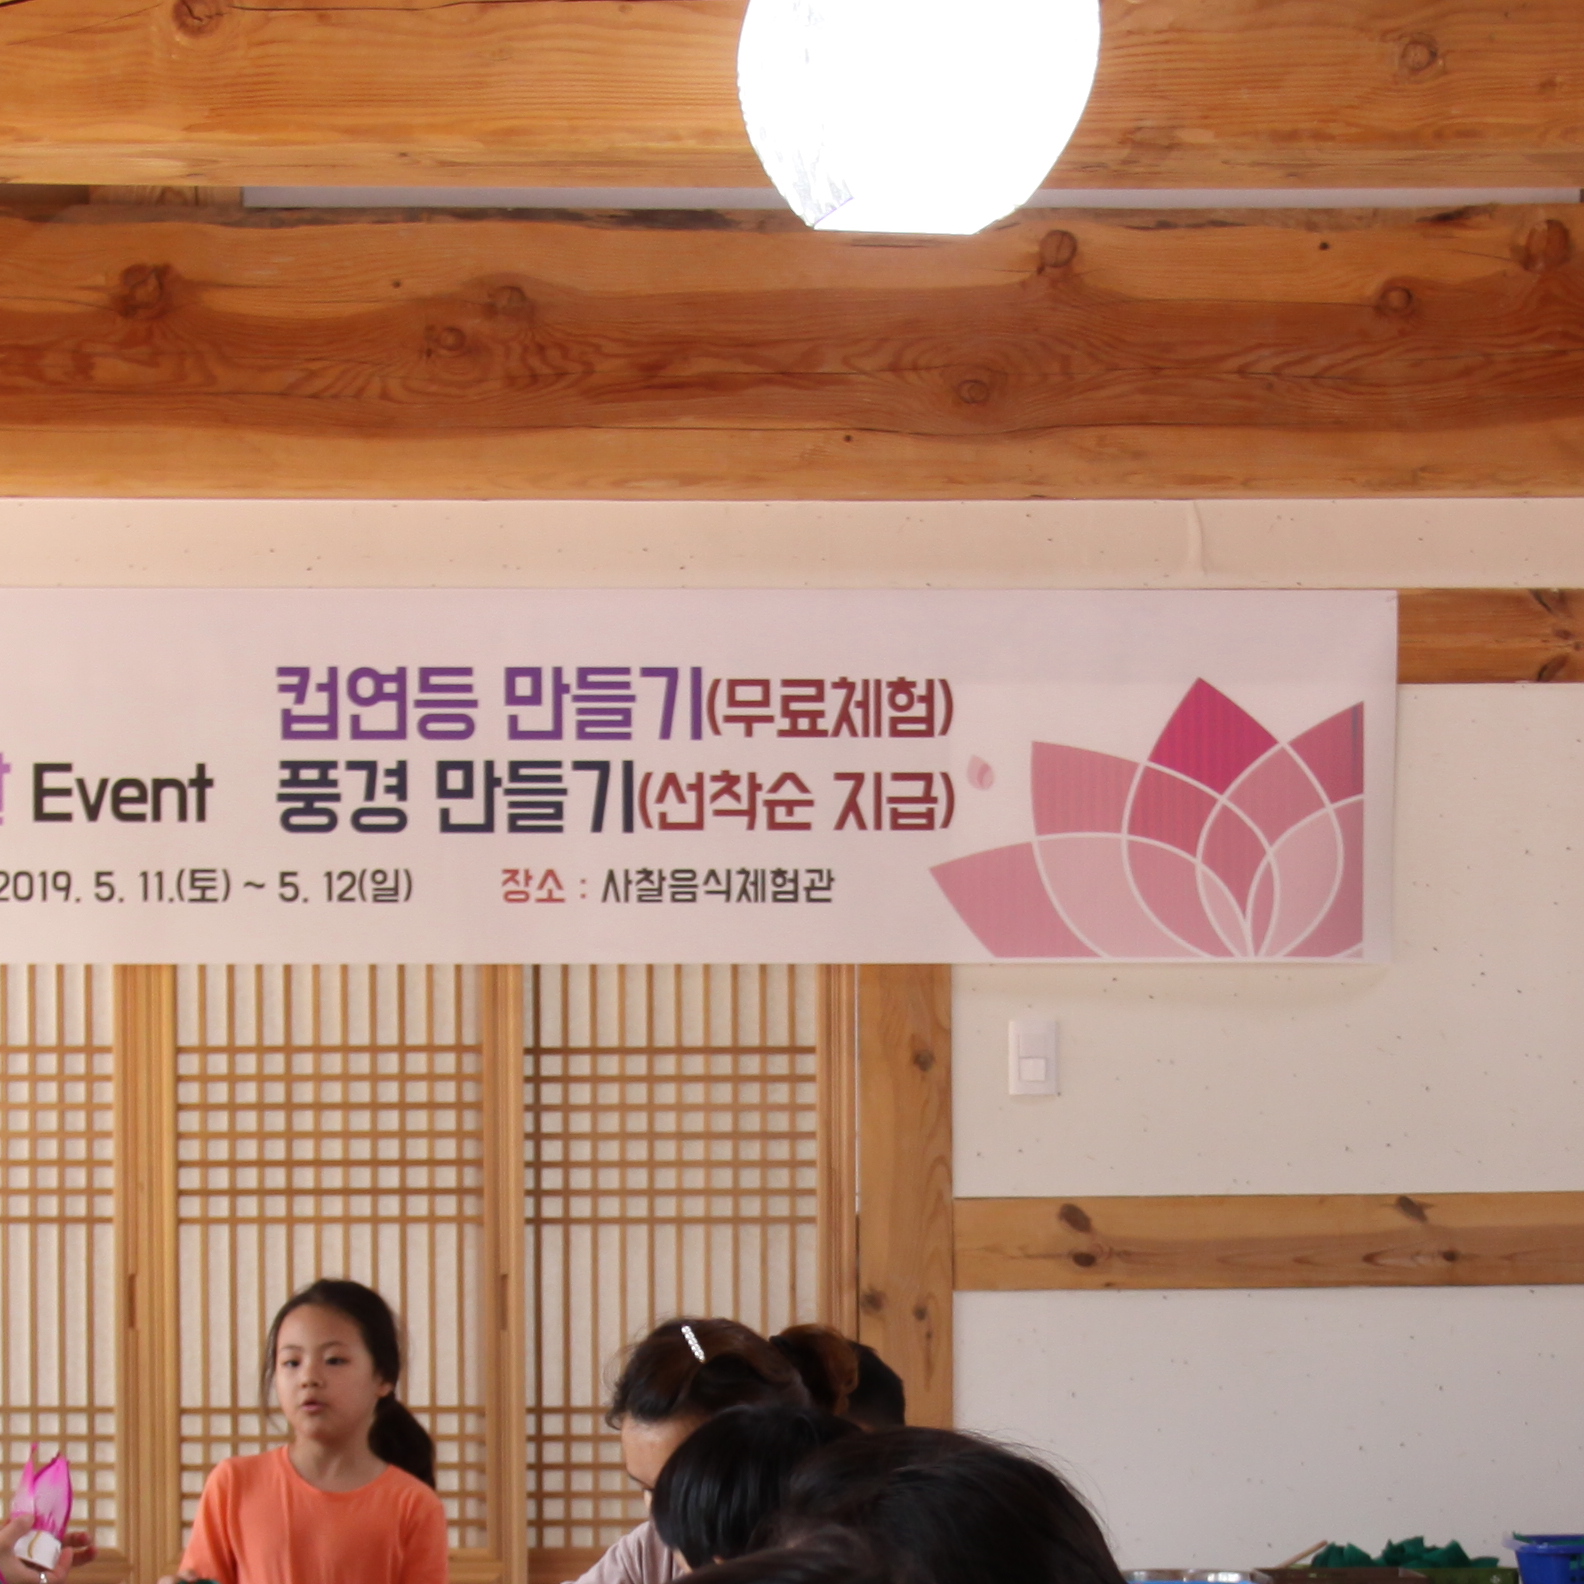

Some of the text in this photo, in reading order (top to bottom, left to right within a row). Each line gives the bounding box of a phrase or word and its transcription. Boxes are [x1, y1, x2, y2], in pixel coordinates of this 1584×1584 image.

[275, 665, 955, 741] 컵연등 만들기(무료체험)
[32, 761, 216, 824] Event
[275, 759, 956, 835] 풍경 만들기(선착순 지급)
[94, 870, 125, 904] 5.
[139, 868, 232, 904] 11.(토)
[278, 870, 309, 904] 5.
[323, 868, 414, 904] 12(일)
[501, 868, 566, 904] 장소
[600, 866, 836, 904] 사찰음식체험관
